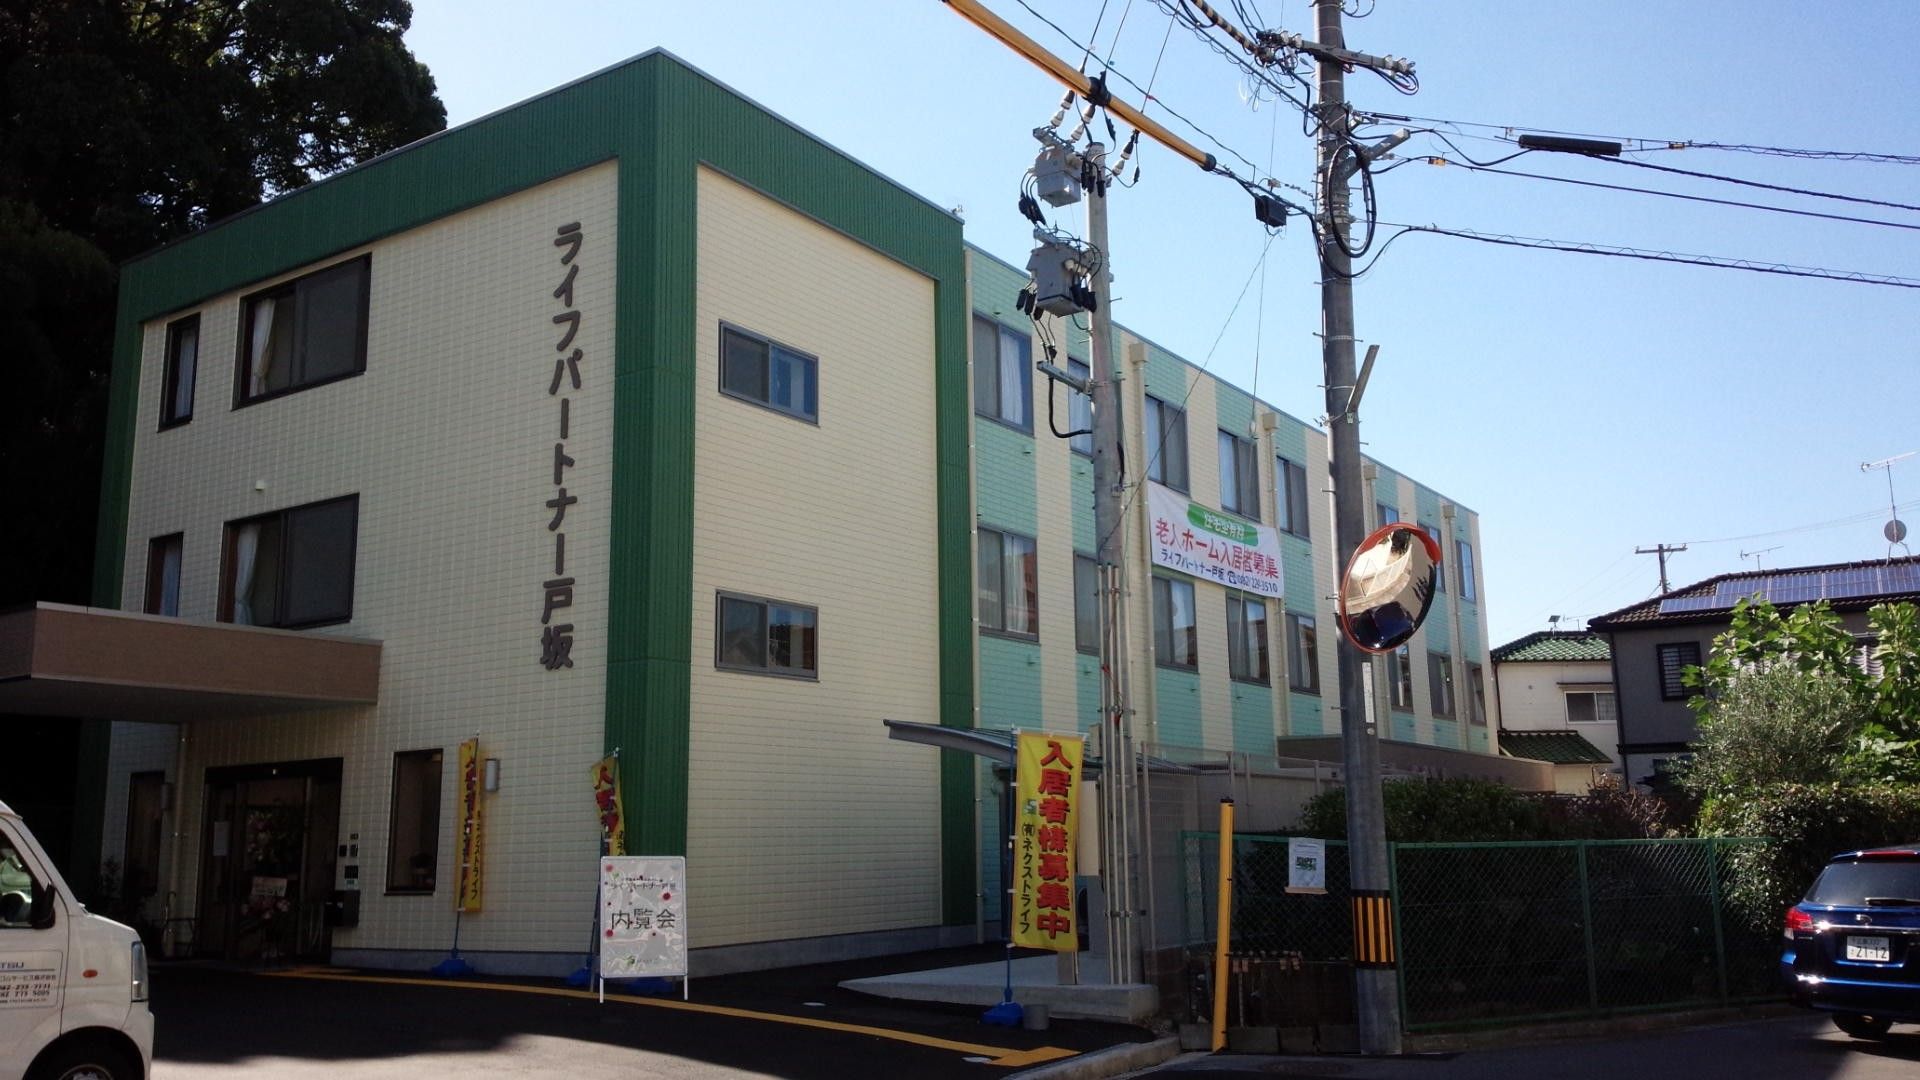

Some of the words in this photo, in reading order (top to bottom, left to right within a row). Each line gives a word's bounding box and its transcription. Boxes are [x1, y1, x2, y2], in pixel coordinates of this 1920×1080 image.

[540, 221, 584, 671] ライフパートナー戸坂
[1155, 517, 1278, 578] 老人ホーム入居者募集
[1037, 740, 1073, 939] 入居者様募集中
[611, 908, 676, 930] 内覧会
